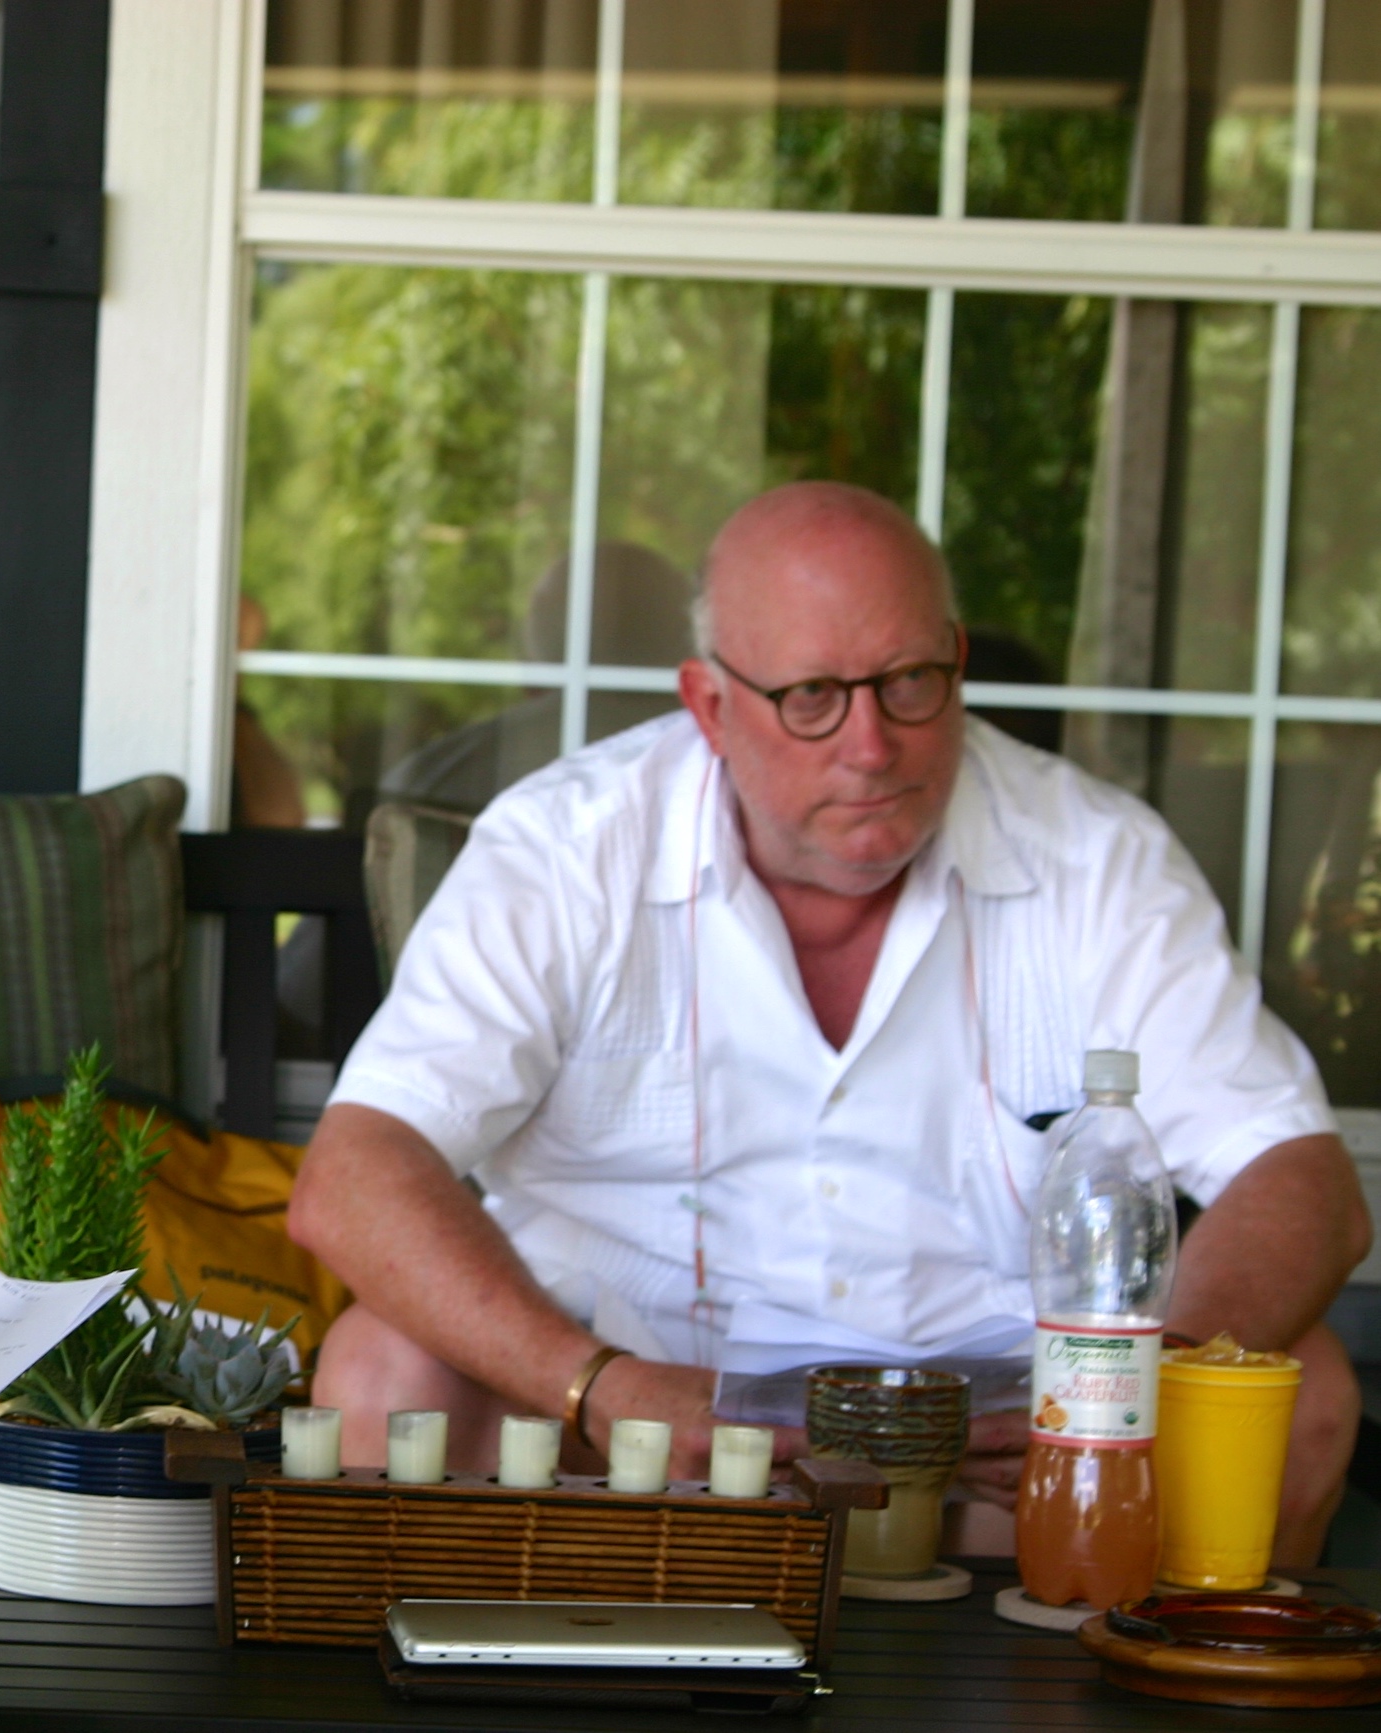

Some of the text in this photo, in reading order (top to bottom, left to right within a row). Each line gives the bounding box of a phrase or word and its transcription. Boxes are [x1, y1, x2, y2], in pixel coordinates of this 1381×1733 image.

[1047, 1335, 1131, 1368] Organics
[1074, 1374, 1140, 1389] RUBY RED
[1055, 1384, 1139, 1402] GRAPEFRUIT
